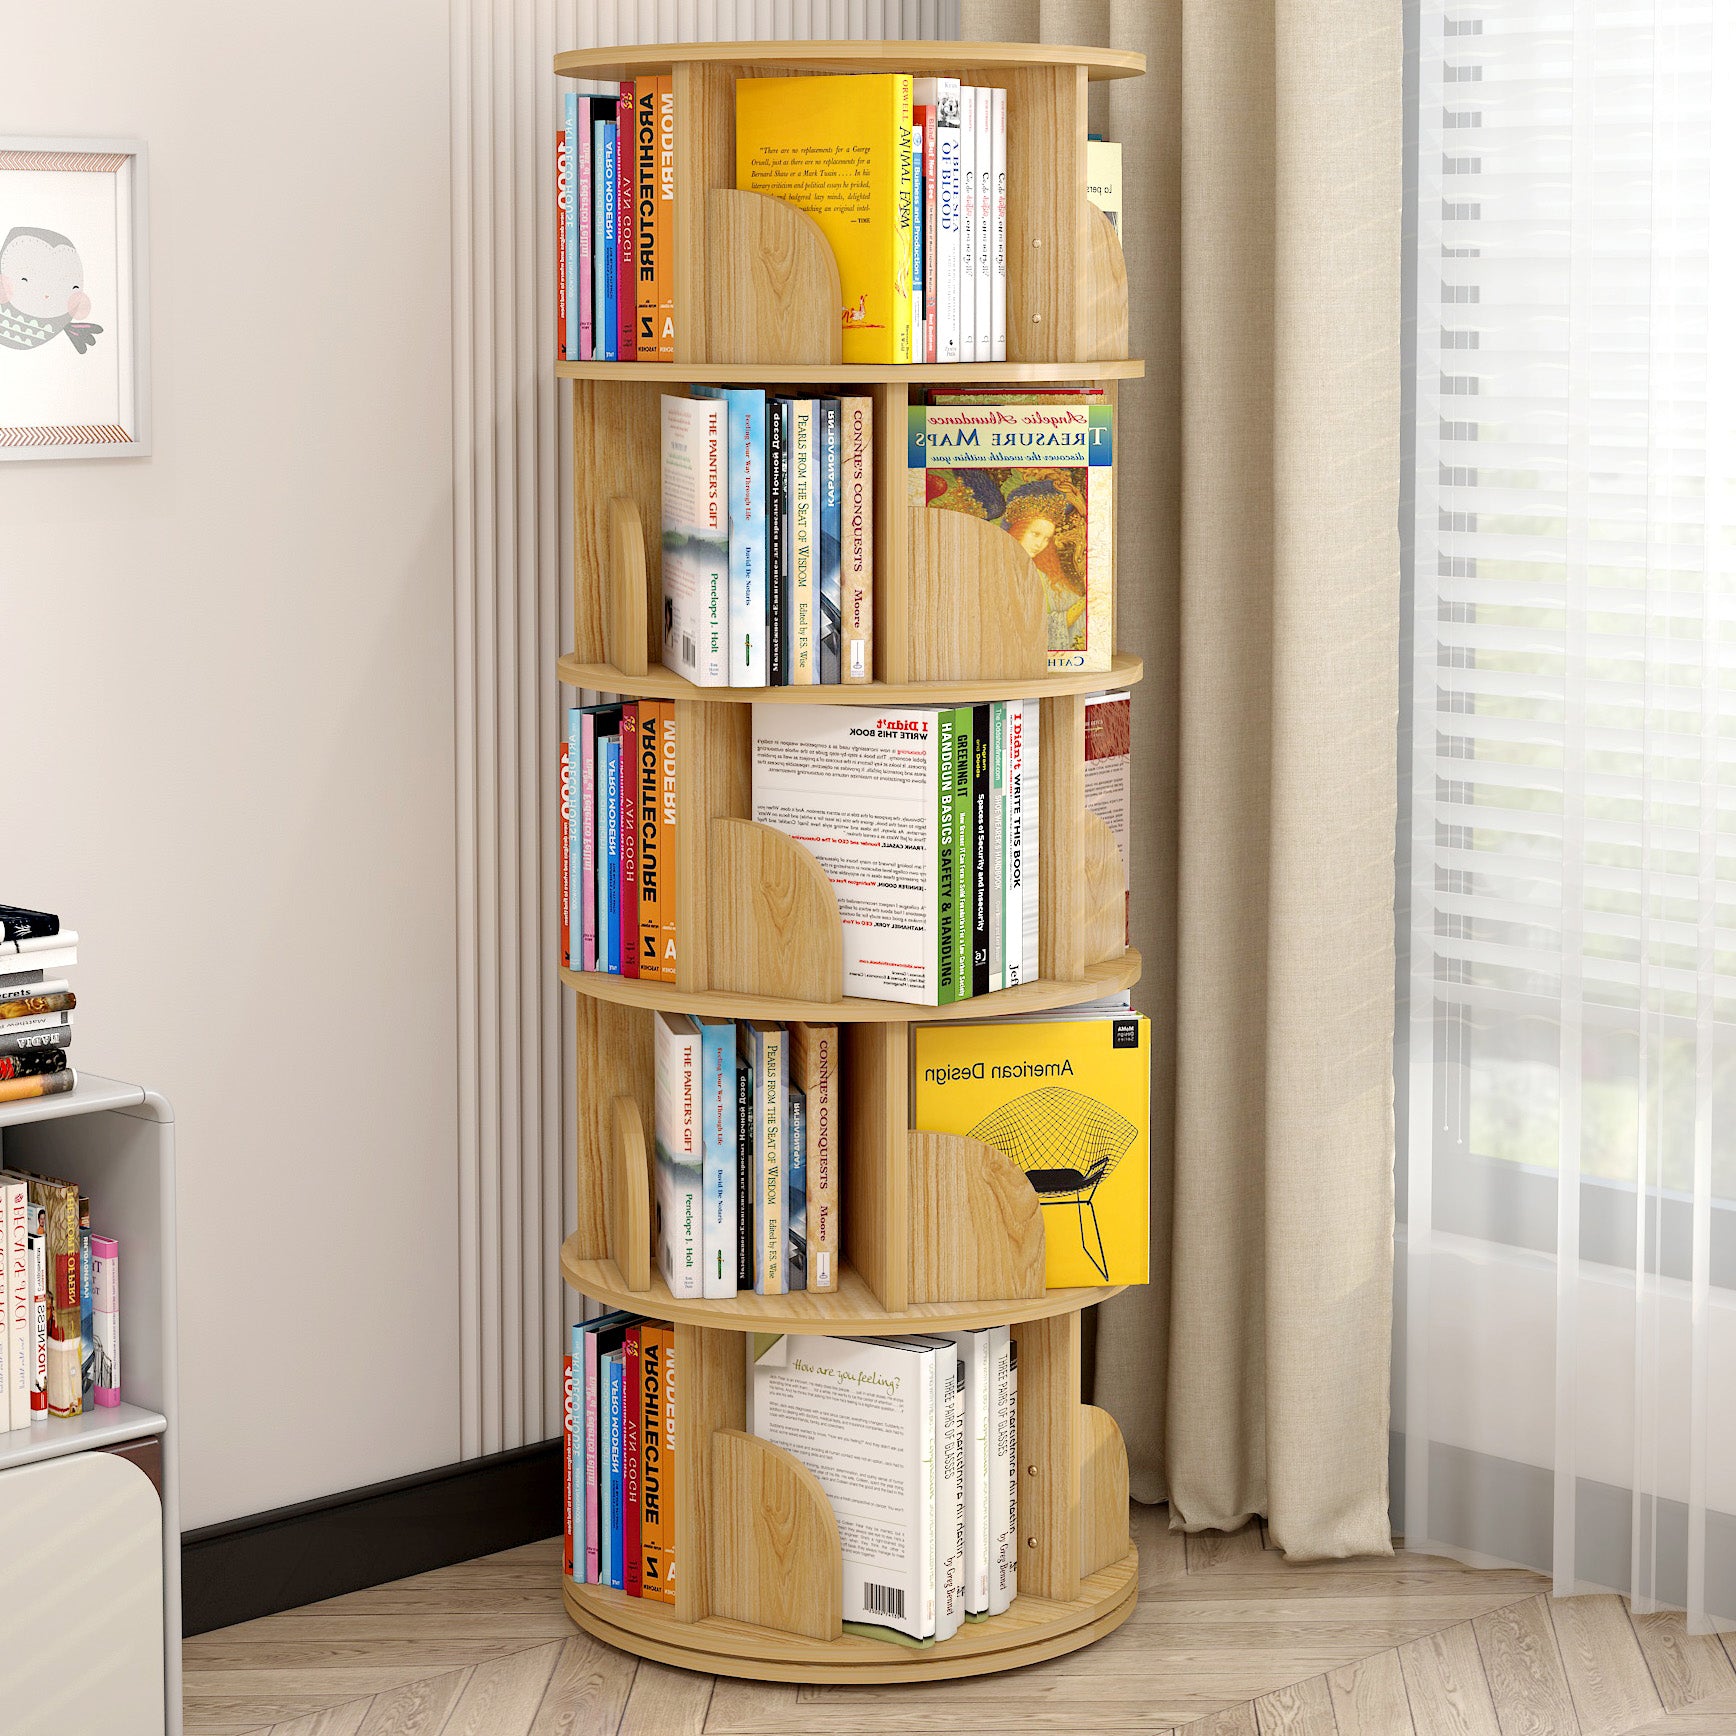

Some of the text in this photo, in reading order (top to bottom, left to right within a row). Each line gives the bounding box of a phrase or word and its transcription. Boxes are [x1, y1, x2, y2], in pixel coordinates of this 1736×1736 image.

[902, 80, 910, 123] ORWELL
[899, 126, 911, 229] ANIMAL FARM
[942, 142, 952, 230] OF BLOOD
[709, 412, 717, 529] THE PAINTER'S GIFT
[773, 412, 781, 496] Ночной Дозор
[826, 410, 835, 507] КАРДИОЛОГИЯ
[798, 415, 809, 588] PEARLS FROM THE SEAT OF WISDOM
[852, 410, 863, 572] CONNIE'S CONQUESTS
[709, 573, 719, 619] Penelope
[745, 569, 751, 579] De
[853, 590, 862, 629] Moore
[709, 632, 719, 653] Holt
[957, 734, 969, 798] GREENING IT
[976, 794, 985, 825] Spaces
[1014, 713, 1022, 889] I Didn't WRITE THIS BOOK
[942, 722, 952, 987] HANDGUN BASICS SAFETY & HANDLING
[976, 835, 985, 869] Security
[976, 872, 985, 887] and
[976, 889, 985, 931] Insecurity
[0, 989, 31, 1000] crets
[684, 1046, 692, 1153] THE PAINTER'S GIFT
[818, 1041, 829, 1189] CONNIE'S CONQUESTS
[793, 1102, 801, 1169] КАРДИОЛОГИЯ
[685, 1193, 694, 1236] Penelope
[820, 1206, 828, 1241] Moore
[685, 1247, 694, 1267] Holt
[792, 1359, 901, 1396] How are you feeling?
[945, 1375, 955, 1480] THREE PAIRS OF GLASSES
